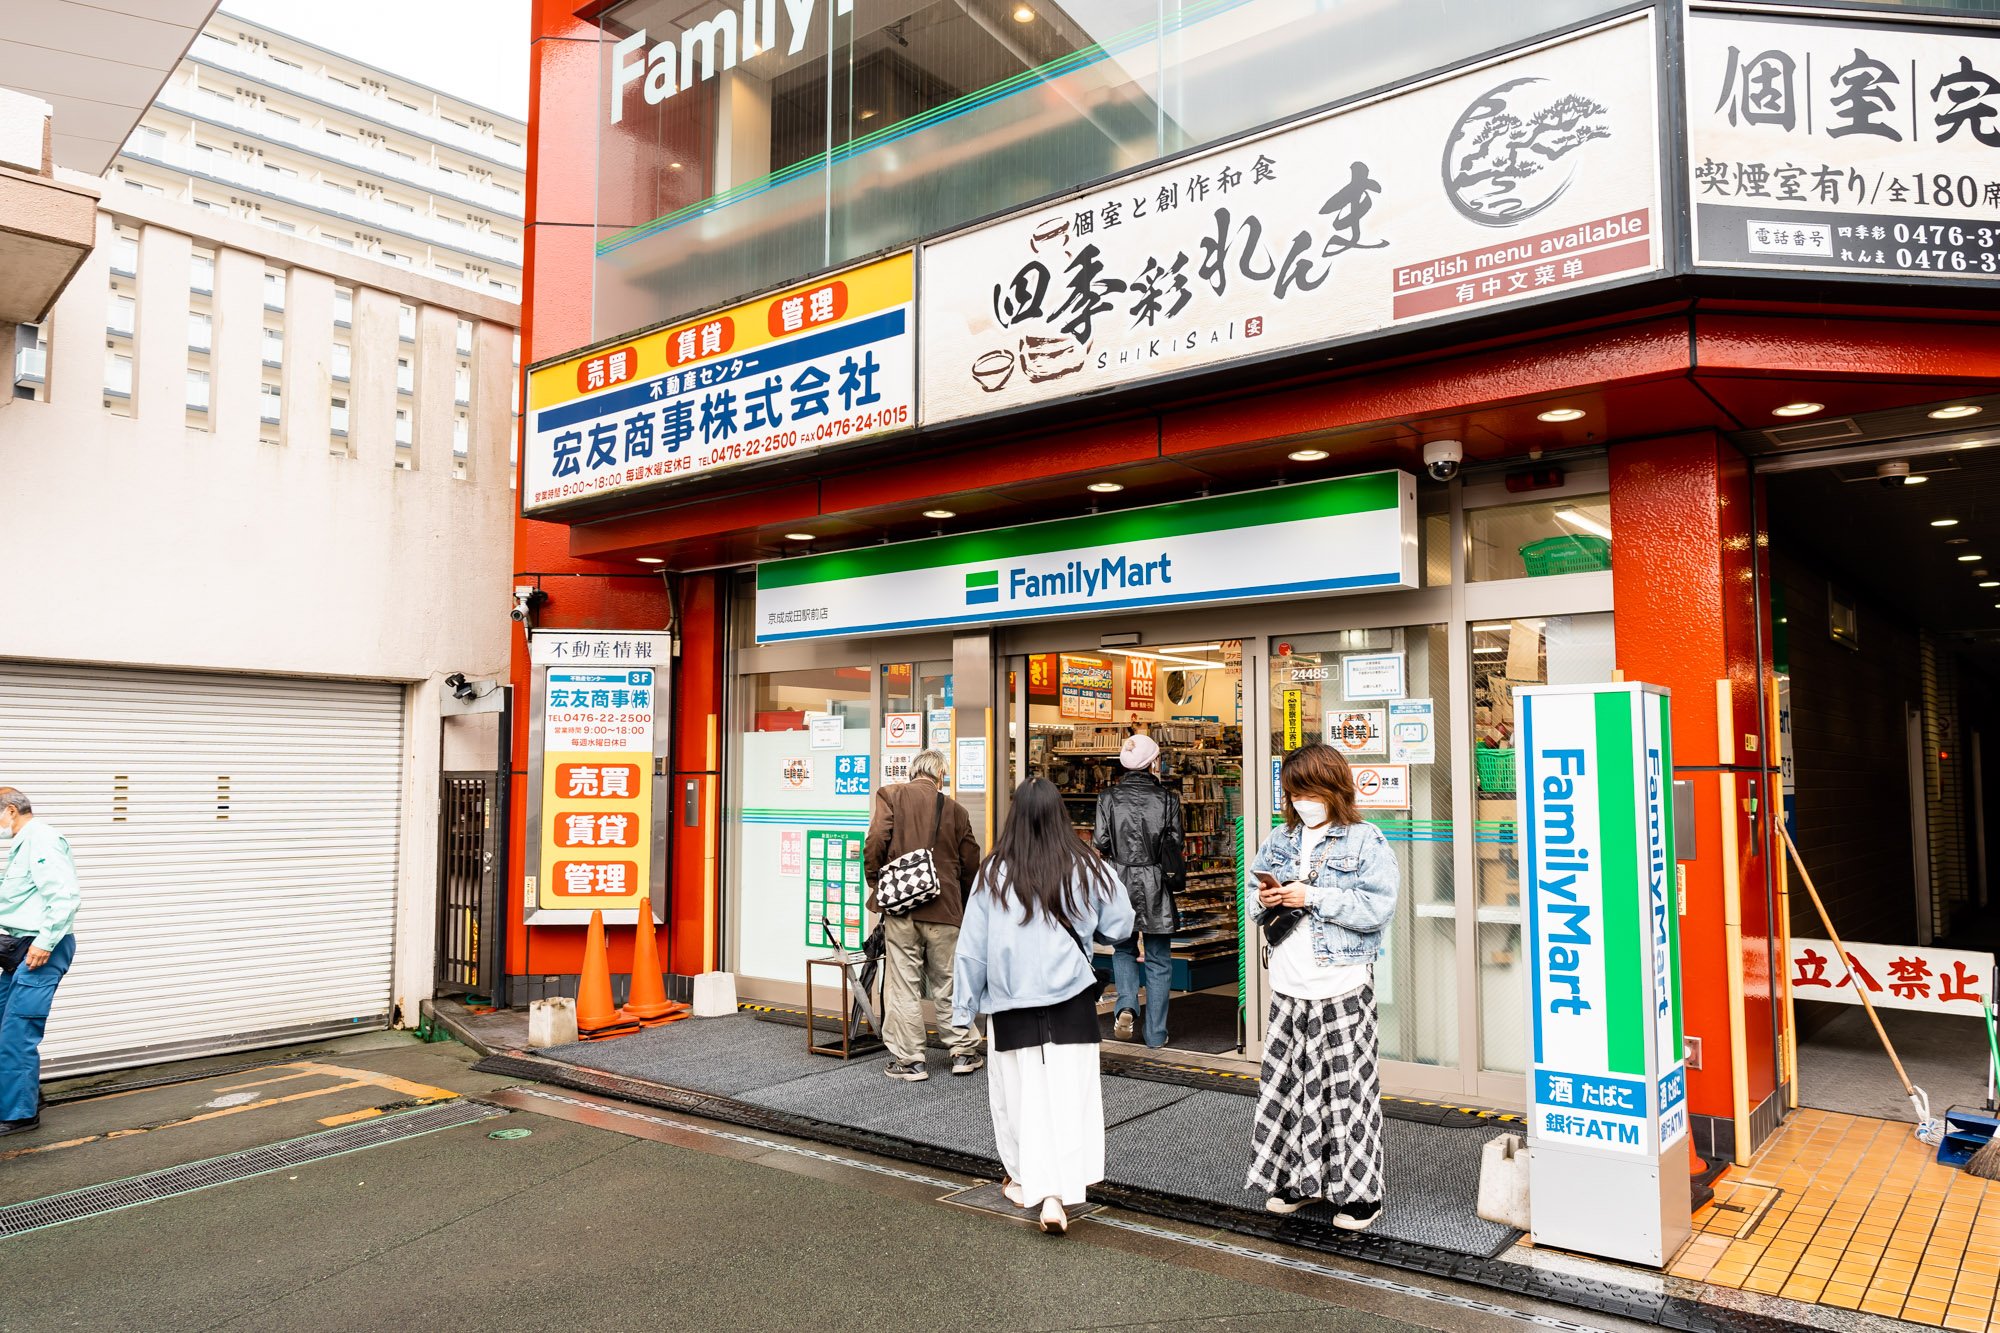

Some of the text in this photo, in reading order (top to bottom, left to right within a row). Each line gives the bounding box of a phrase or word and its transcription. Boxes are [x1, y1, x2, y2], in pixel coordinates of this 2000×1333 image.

[610, 0, 854, 125] Family
[1071, 154, 1277, 237] 個室と創作和食
[1755, 227, 1824, 247] 電話番号
[1838, 224, 1886, 240] 四季彩
[1398, 217, 1642, 286] English menu available
[1840, 247, 2000, 273] れんま 0476-3
[1456, 258, 1584, 303] 有中文菜单
[782, 287, 834, 332] 管理
[677, 322, 722, 365] 賃貸
[1097, 325, 1234, 369] SHIKISAI
[586, 353, 627, 391] 売買
[650, 359, 759, 400] 不動産センター
[551, 350, 881, 478] 宏友商事株式会社
[535, 488, 561, 503] 営業時間
[625, 455, 691, 483] 毎週水曜定休日
[1010, 552, 1172, 600] FamilyMart
[768, 607, 828, 625] 京成成田駅前店
[550, 640, 652, 659] 不動産情報
[631, 673, 649, 684] 3F
[1130, 660, 1153, 679] TAX
[1291, 668, 1329, 681] 24485
[1131, 680, 1153, 697] FREE
[1330, 724, 1379, 740] 駐輪禁止
[569, 766, 630, 797] 売買
[839, 757, 866, 773] お酒
[836, 777, 869, 793] たばこ
[566, 814, 627, 846] 賃貸
[565, 863, 627, 894] 管理
[1538, 748, 1592, 1016] FamilyMart
[1649, 748, 1669, 1019] FamilyMart
[1792, 948, 1985, 1005] 立入禁止
[1549, 1075, 1634, 1109] 酒 たばこ
[1546, 1112, 1639, 1145] 銀行ATM
